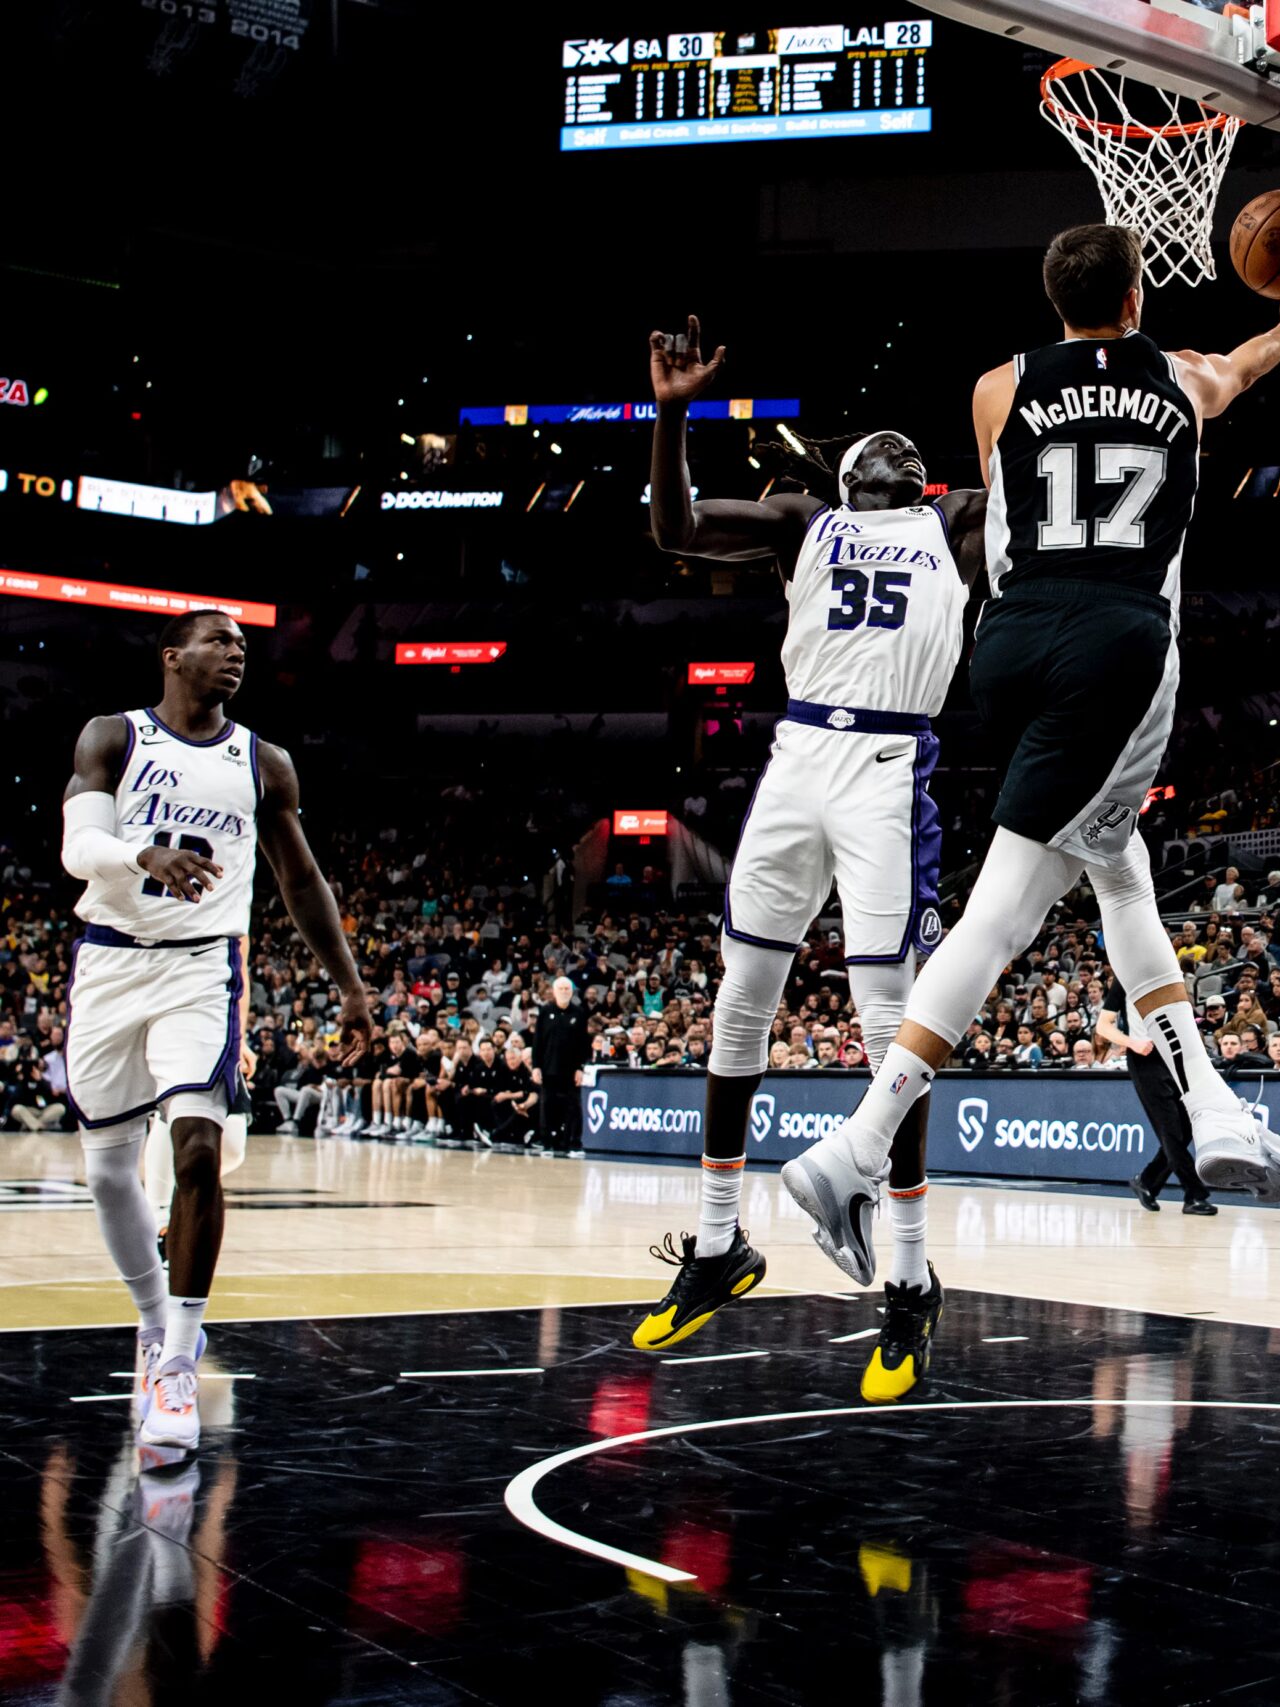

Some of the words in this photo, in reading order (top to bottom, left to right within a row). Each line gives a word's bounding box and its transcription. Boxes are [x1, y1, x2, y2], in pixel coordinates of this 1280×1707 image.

[231, 18, 300, 51] 2014
[633, 38, 662, 60] SA
[679, 36, 703, 57] 30
[843, 26, 885, 47] LAL
[896, 24, 922, 45] 28
[1019, 385, 1189, 444] McDERMOTT
[18, 472, 56, 497] TO
[924, 484, 948, 496] ORTS
[1037, 442, 1168, 551] 17
[814, 536, 941, 571] ANGELES
[827, 568, 912, 631] 35
[123, 792, 247, 837] ANGELES
